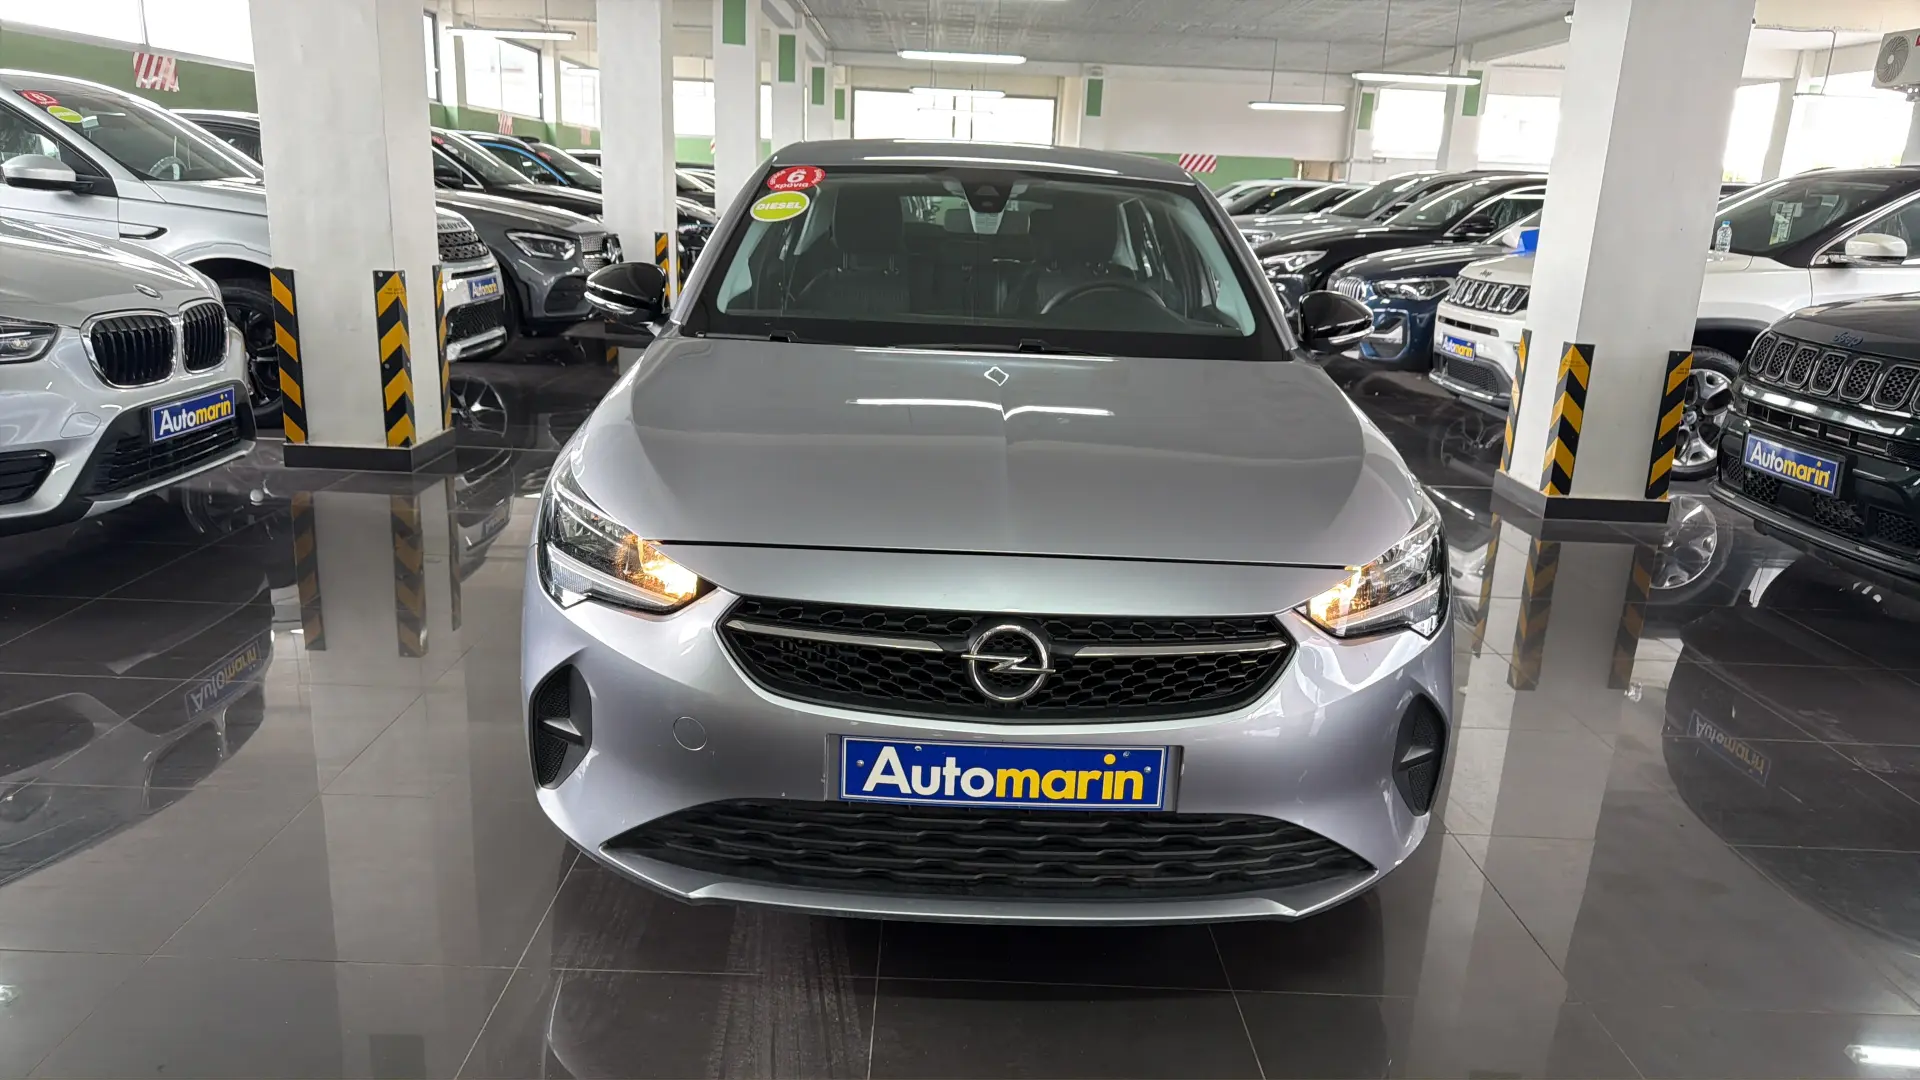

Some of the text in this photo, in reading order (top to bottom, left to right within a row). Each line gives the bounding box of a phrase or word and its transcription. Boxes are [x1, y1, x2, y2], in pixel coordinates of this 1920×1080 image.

[787, 170, 807, 183] 6
[755, 201, 802, 210] DIESEL
[159, 394, 231, 436] Automarin
[1749, 441, 1831, 488] Automarin
[862, 745, 1144, 800] Automarin
